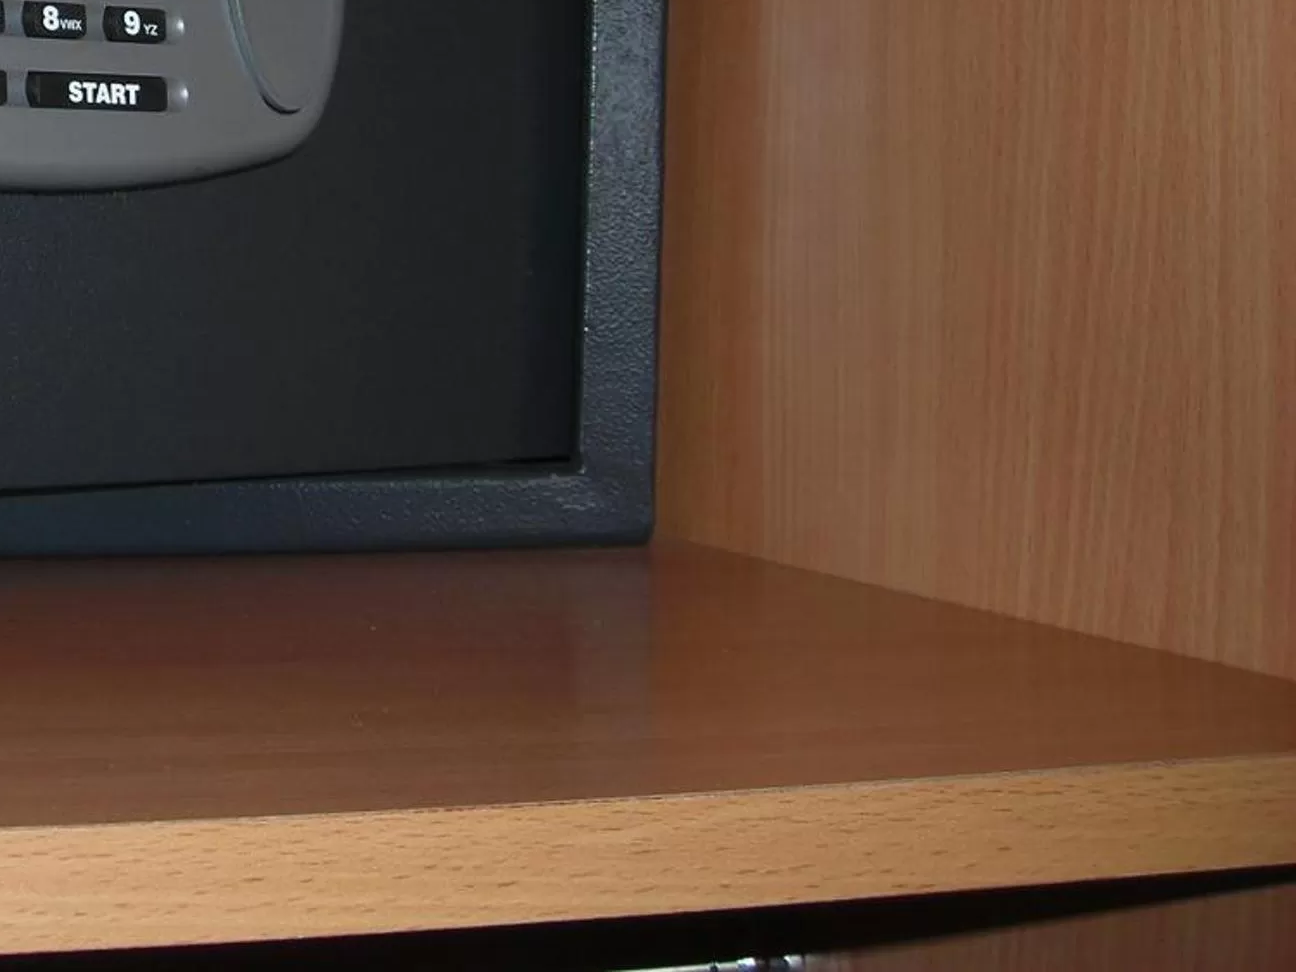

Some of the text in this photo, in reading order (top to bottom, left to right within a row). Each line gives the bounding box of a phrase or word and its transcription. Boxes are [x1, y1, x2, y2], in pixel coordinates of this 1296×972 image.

[42, 5, 59, 31] 8
[124, 10, 158, 36] 9 YZ
[69, 81, 140, 105] START
